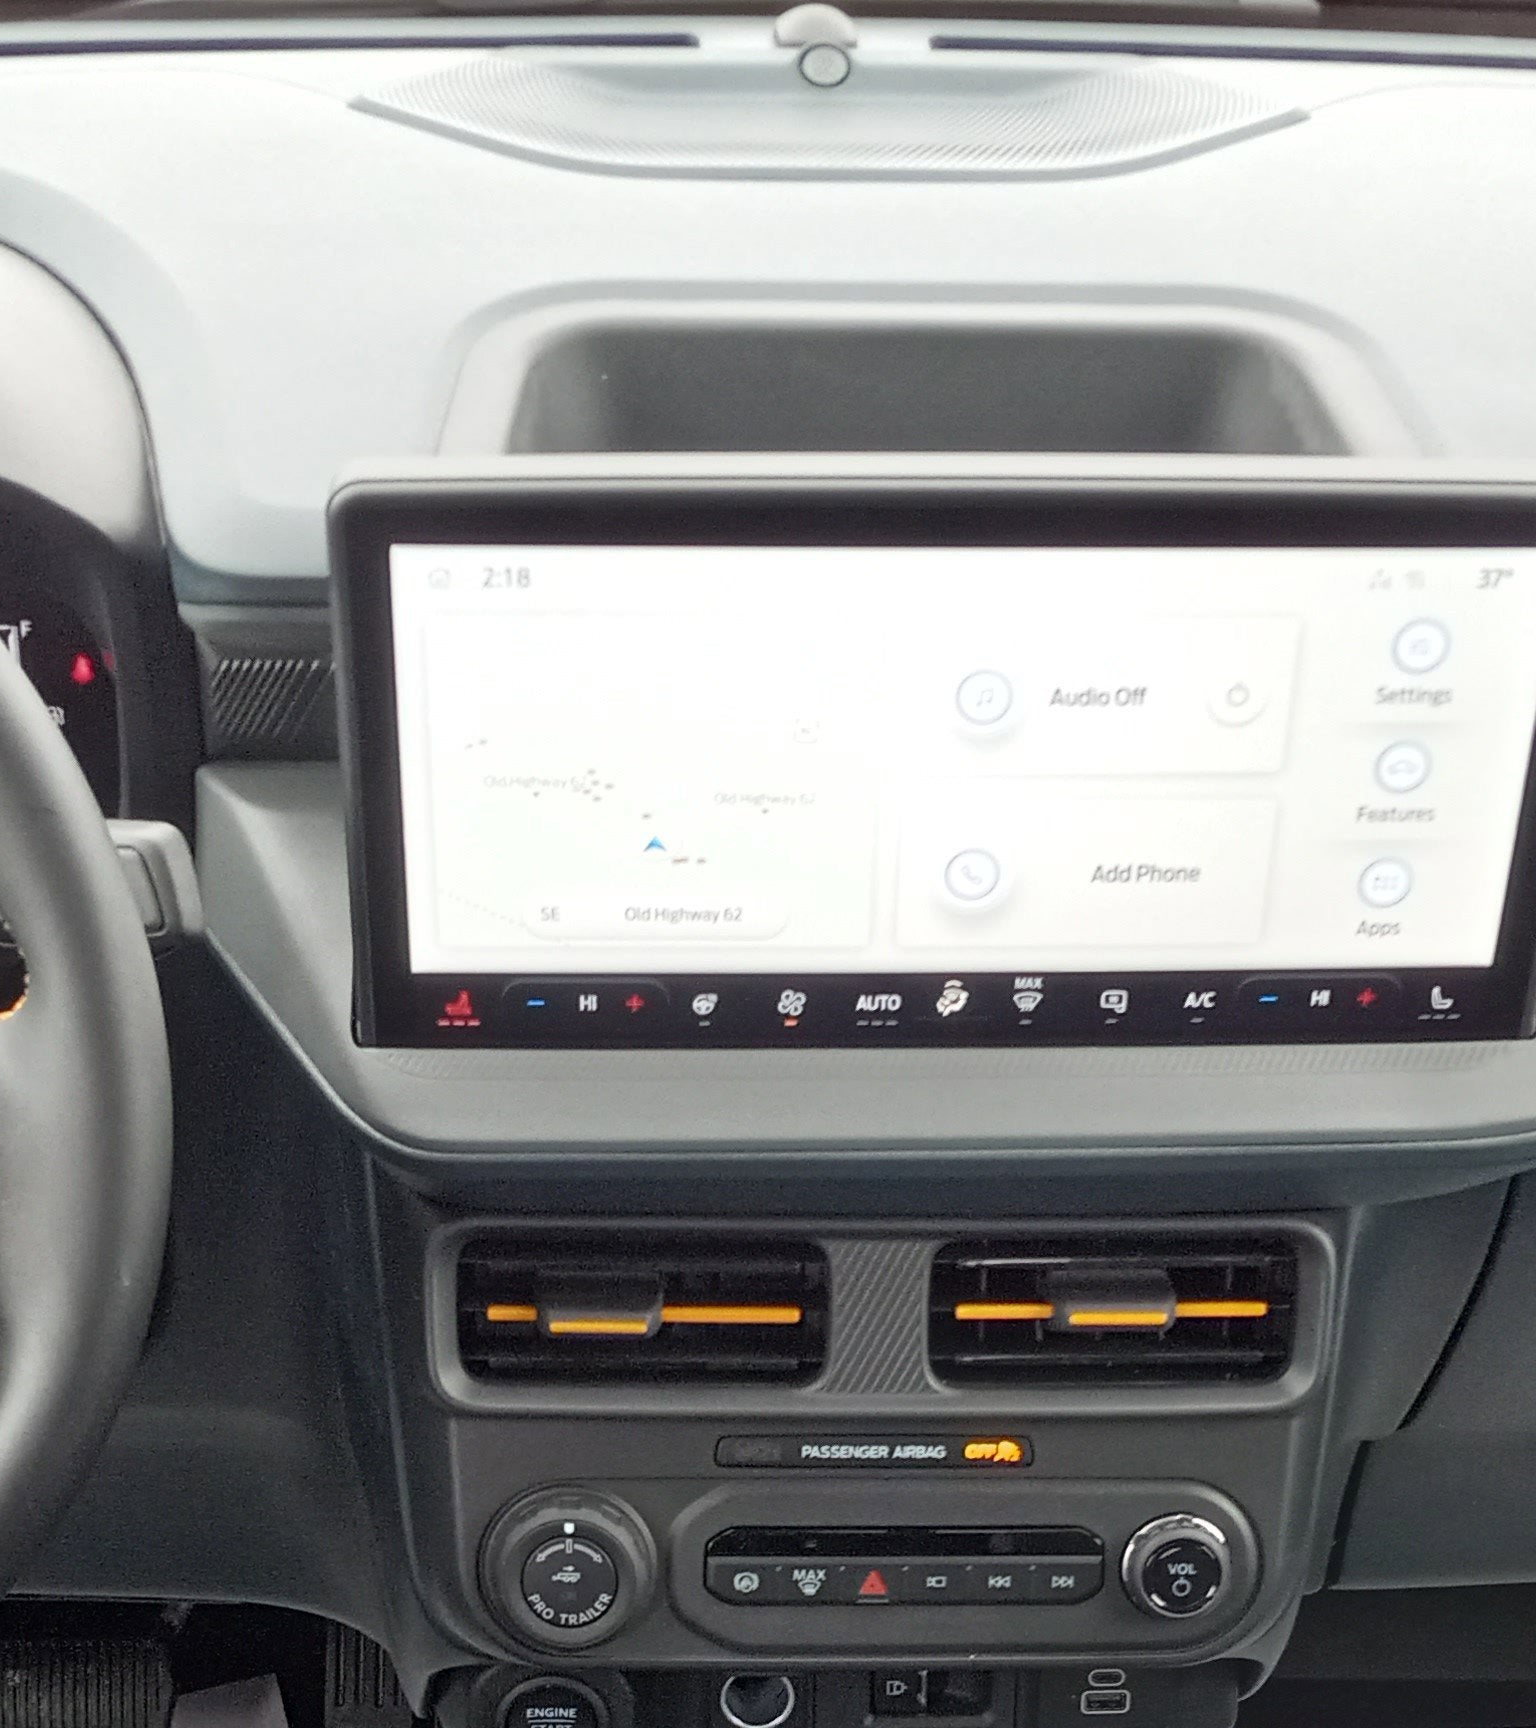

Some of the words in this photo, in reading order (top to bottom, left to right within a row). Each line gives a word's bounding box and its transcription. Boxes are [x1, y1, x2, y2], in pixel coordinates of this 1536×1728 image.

[482, 567, 532, 589] 2:18
[1049, 686, 1109, 707] Audio
[1115, 686, 1148, 707] Off
[1375, 686, 1453, 709] Settings
[1355, 805, 1436, 824] Features
[1091, 864, 1132, 884] Add
[1137, 864, 1201, 884] Phone
[624, 906, 652, 922] Old
[655, 906, 720, 924] Highway
[723, 906, 744, 922] 62
[1355, 919, 1401, 940] Apps
[1014, 977, 1043, 990] MAX
[579, 994, 598, 1012] HI
[855, 994, 902, 1012] AUTO
[1183, 991, 1216, 1010] A/C
[1310, 990, 1331, 1008] HI
[800, 1444, 889, 1460] PASSENGER
[892, 1444, 948, 1461] AIRBAG
[792, 1568, 827, 1582] MAX
[1167, 1562, 1198, 1575] VOL
[527, 1592, 555, 1620] PRO
[559, 1592, 613, 1626] TRAILER
[526, 1707, 577, 1719] ENGINE
